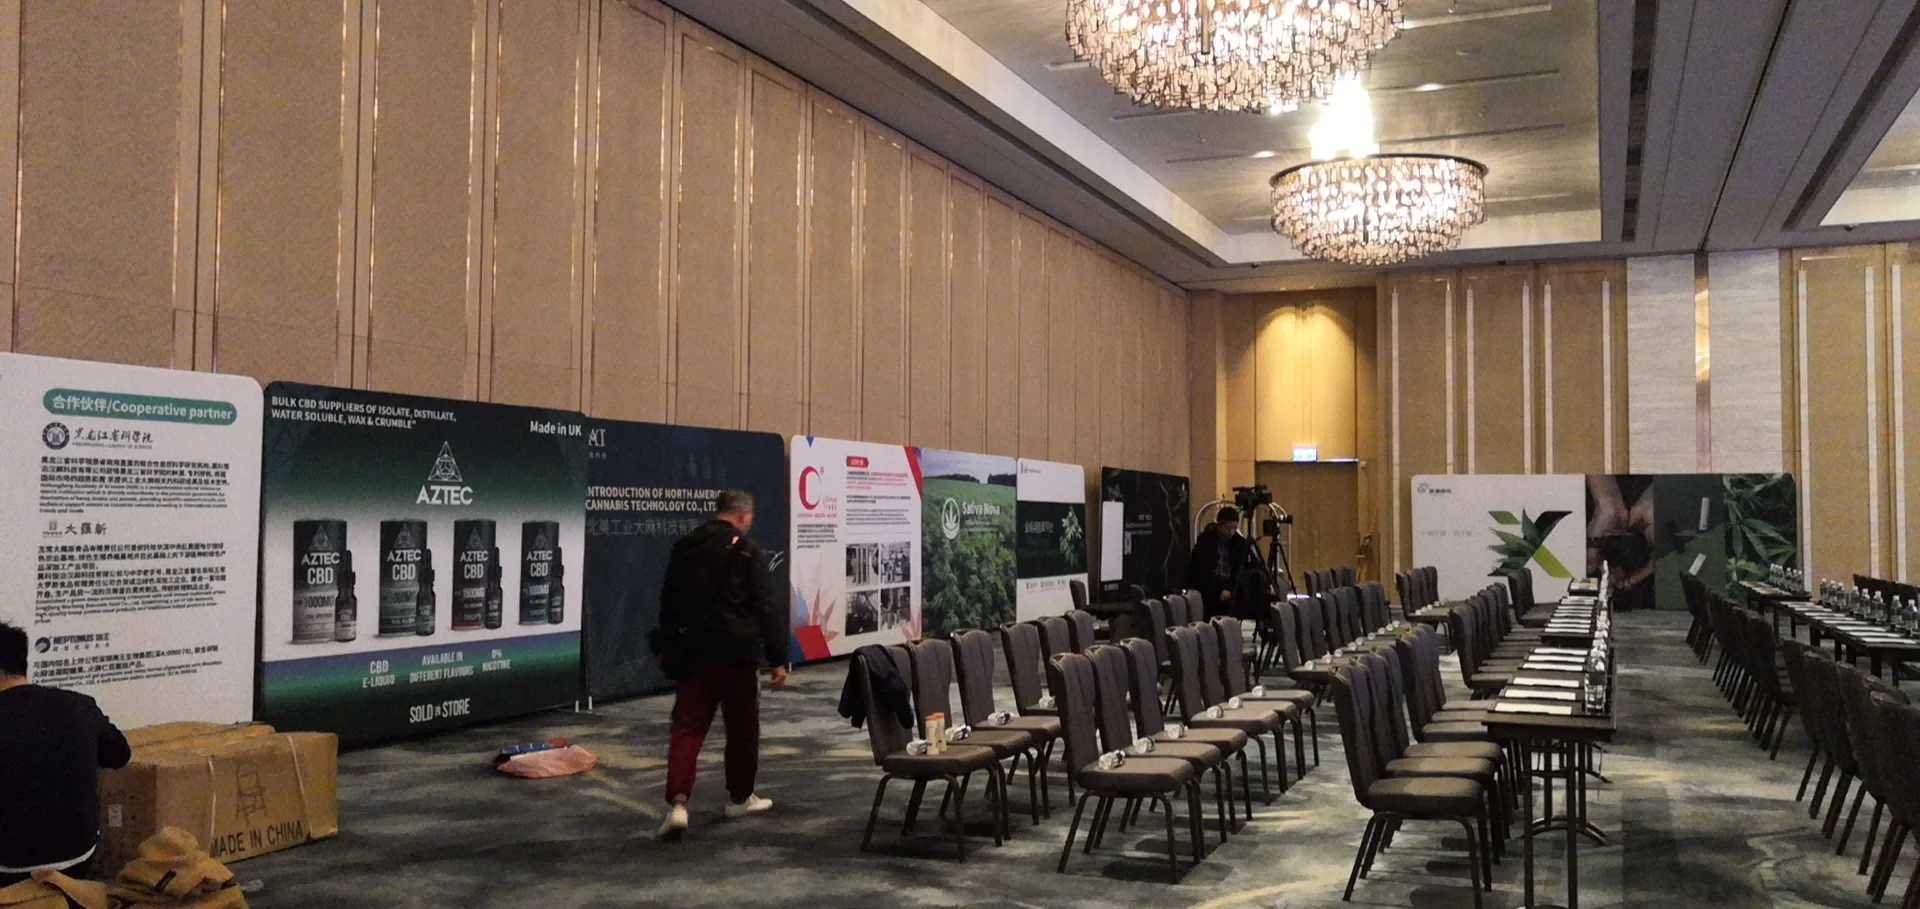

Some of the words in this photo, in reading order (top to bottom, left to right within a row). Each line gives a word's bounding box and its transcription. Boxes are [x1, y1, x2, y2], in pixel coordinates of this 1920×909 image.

[189, 407, 233, 420] partner
[271, 396, 297, 408] BULK
[298, 398, 317, 409] CBD
[318, 399, 364, 413] SUPPLIERS
[366, 404, 377, 414] OF
[379, 405, 413, 419] ISOLATE,
[414, 409, 457, 423] DISTILLATE,
[271, 408, 303, 420] WATER
[304, 411, 347, 425] SOLUBLE,
[348, 414, 366, 425] WAX
[367, 416, 374, 425] &
[530, 420, 556, 434] Made
[557, 422, 566, 435] in
[568, 424, 582, 436] UK
[416, 485, 473, 505] AZTEC
[588, 486, 650, 498] NTRODUCTION
[652, 487, 663, 498] OF
[665, 488, 692, 499] NORTH
[694, 489, 721, 499] AMERIC
[585, 499, 629, 510] CANNABIS
[631, 500, 685, 511] TECHNOLOGY
[687, 501, 702, 513] CO.,
[962, 501, 983, 515] Sativa
[983, 502, 1000, 515] Nova
[301, 552, 340, 565] AZTEC
[386, 549, 421, 562] AZTEC
[460, 550, 488, 562] AZTEC
[526, 550, 553, 561] AZTEC
[307, 567, 334, 584] CBD
[392, 563, 416, 580] CBD
[464, 563, 484, 579] CBD
[530, 562, 548, 577] CBD
[53, 634, 94, 644] NEPTUNUS
[422, 652, 456, 665] AVAILABLE
[456, 651, 463, 662] IN
[370, 660, 389, 674] CBD
[482, 660, 511, 672] NICOTINE
[362, 674, 395, 688] E-LIQUID
[409, 669, 443, 683] DIFFERENT
[443, 665, 474, 679] FLAVOURS
[409, 704, 434, 723] SOLD
[442, 698, 470, 718] STORE
[209, 832, 245, 858] MADE
[249, 828, 262, 848] IN
[267, 820, 303, 844] CHINA
